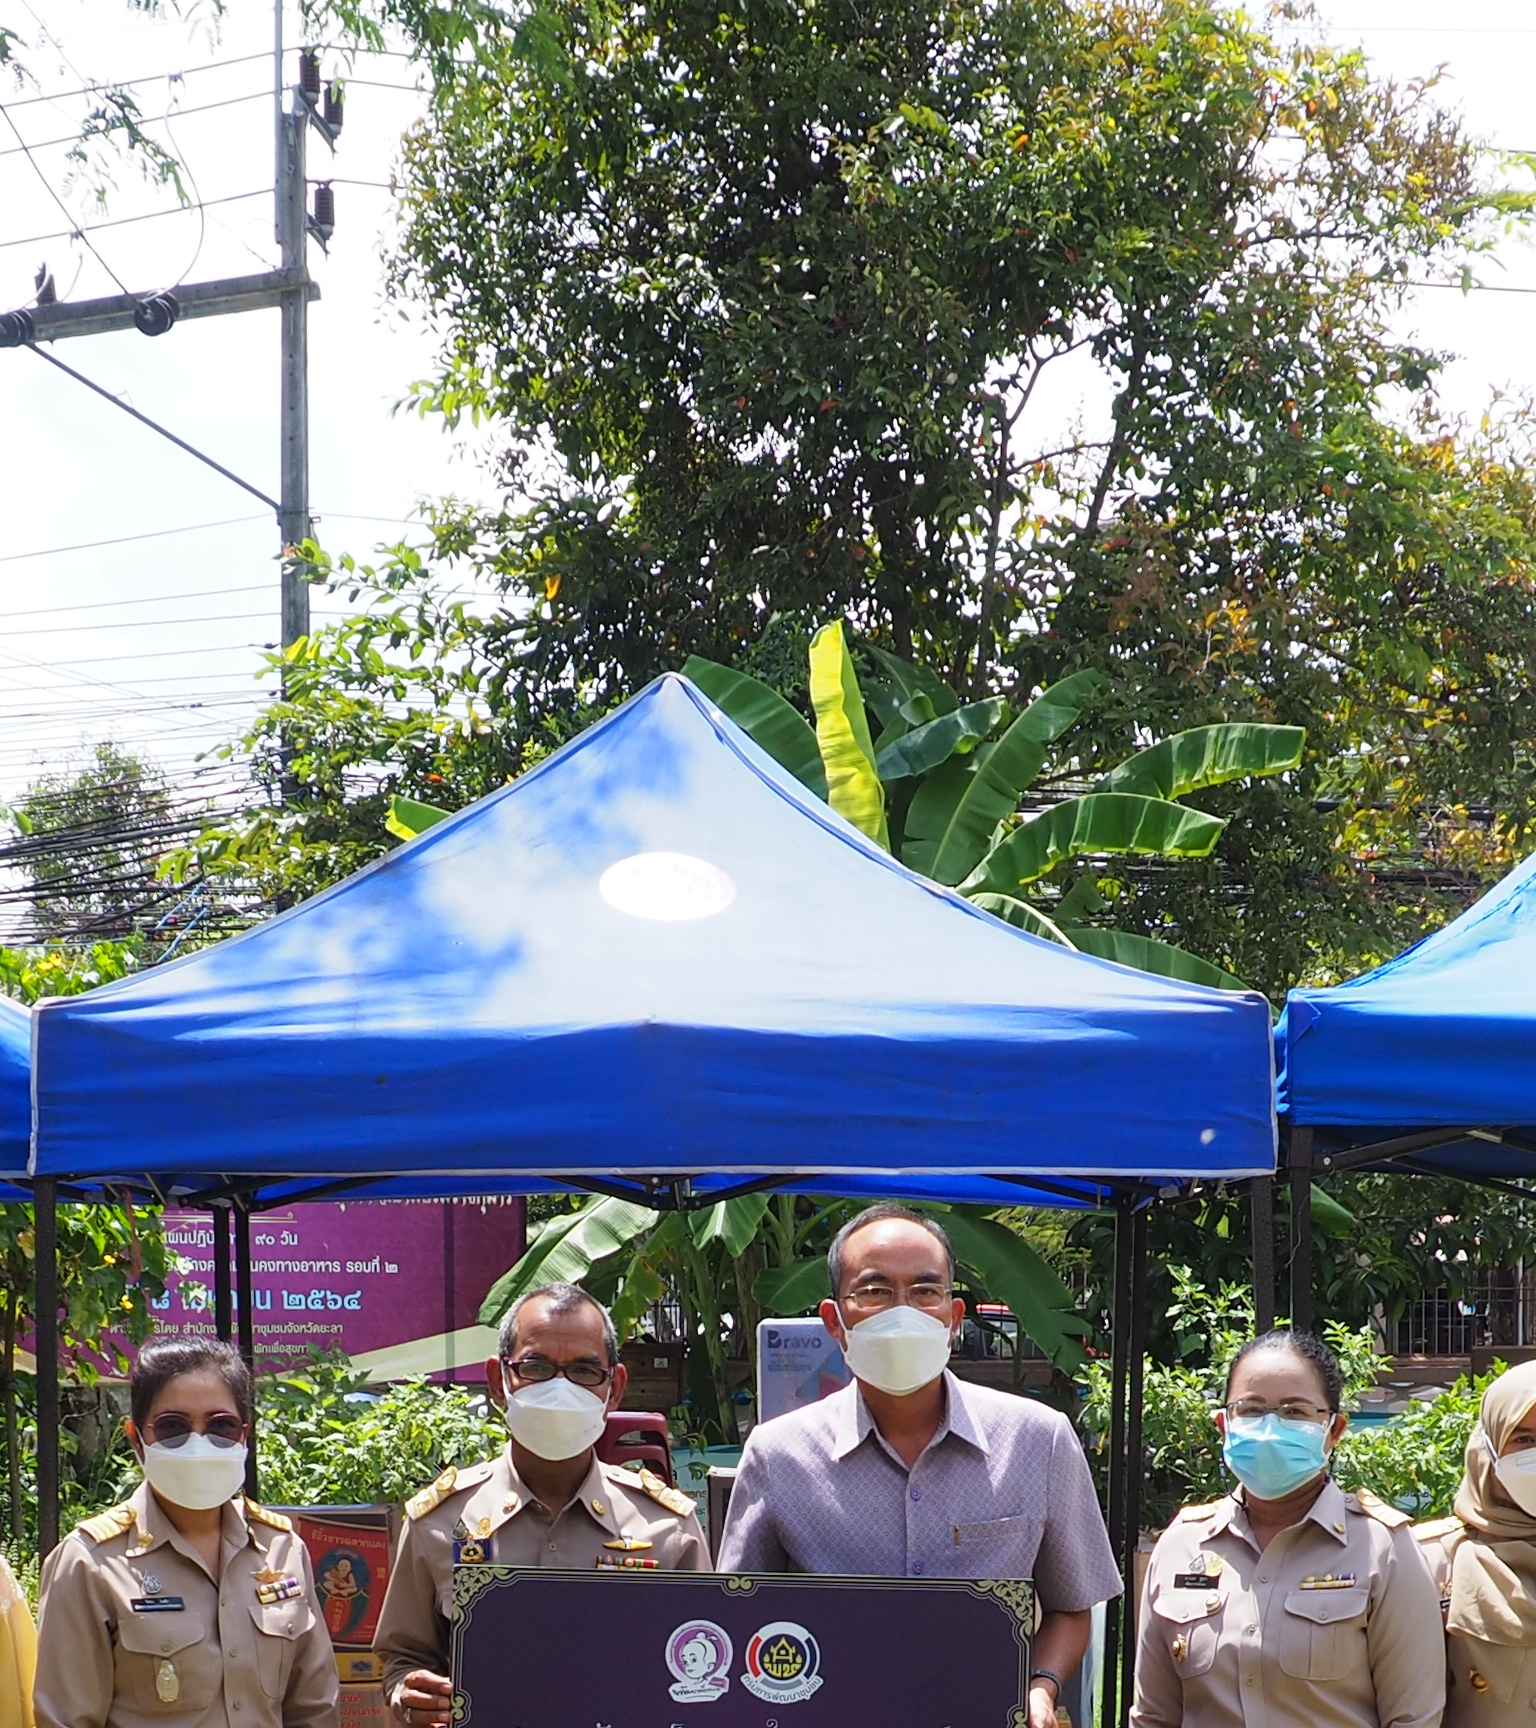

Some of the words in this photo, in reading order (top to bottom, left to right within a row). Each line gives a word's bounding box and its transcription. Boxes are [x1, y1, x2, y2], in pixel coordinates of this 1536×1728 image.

[280, 1229, 298, 1246] วัน
[346, 1255, 380, 1273] รอบที่
[282, 1289, 362, 1311] ๒๕๖๔
[767, 1329, 822, 1349] Bravo
